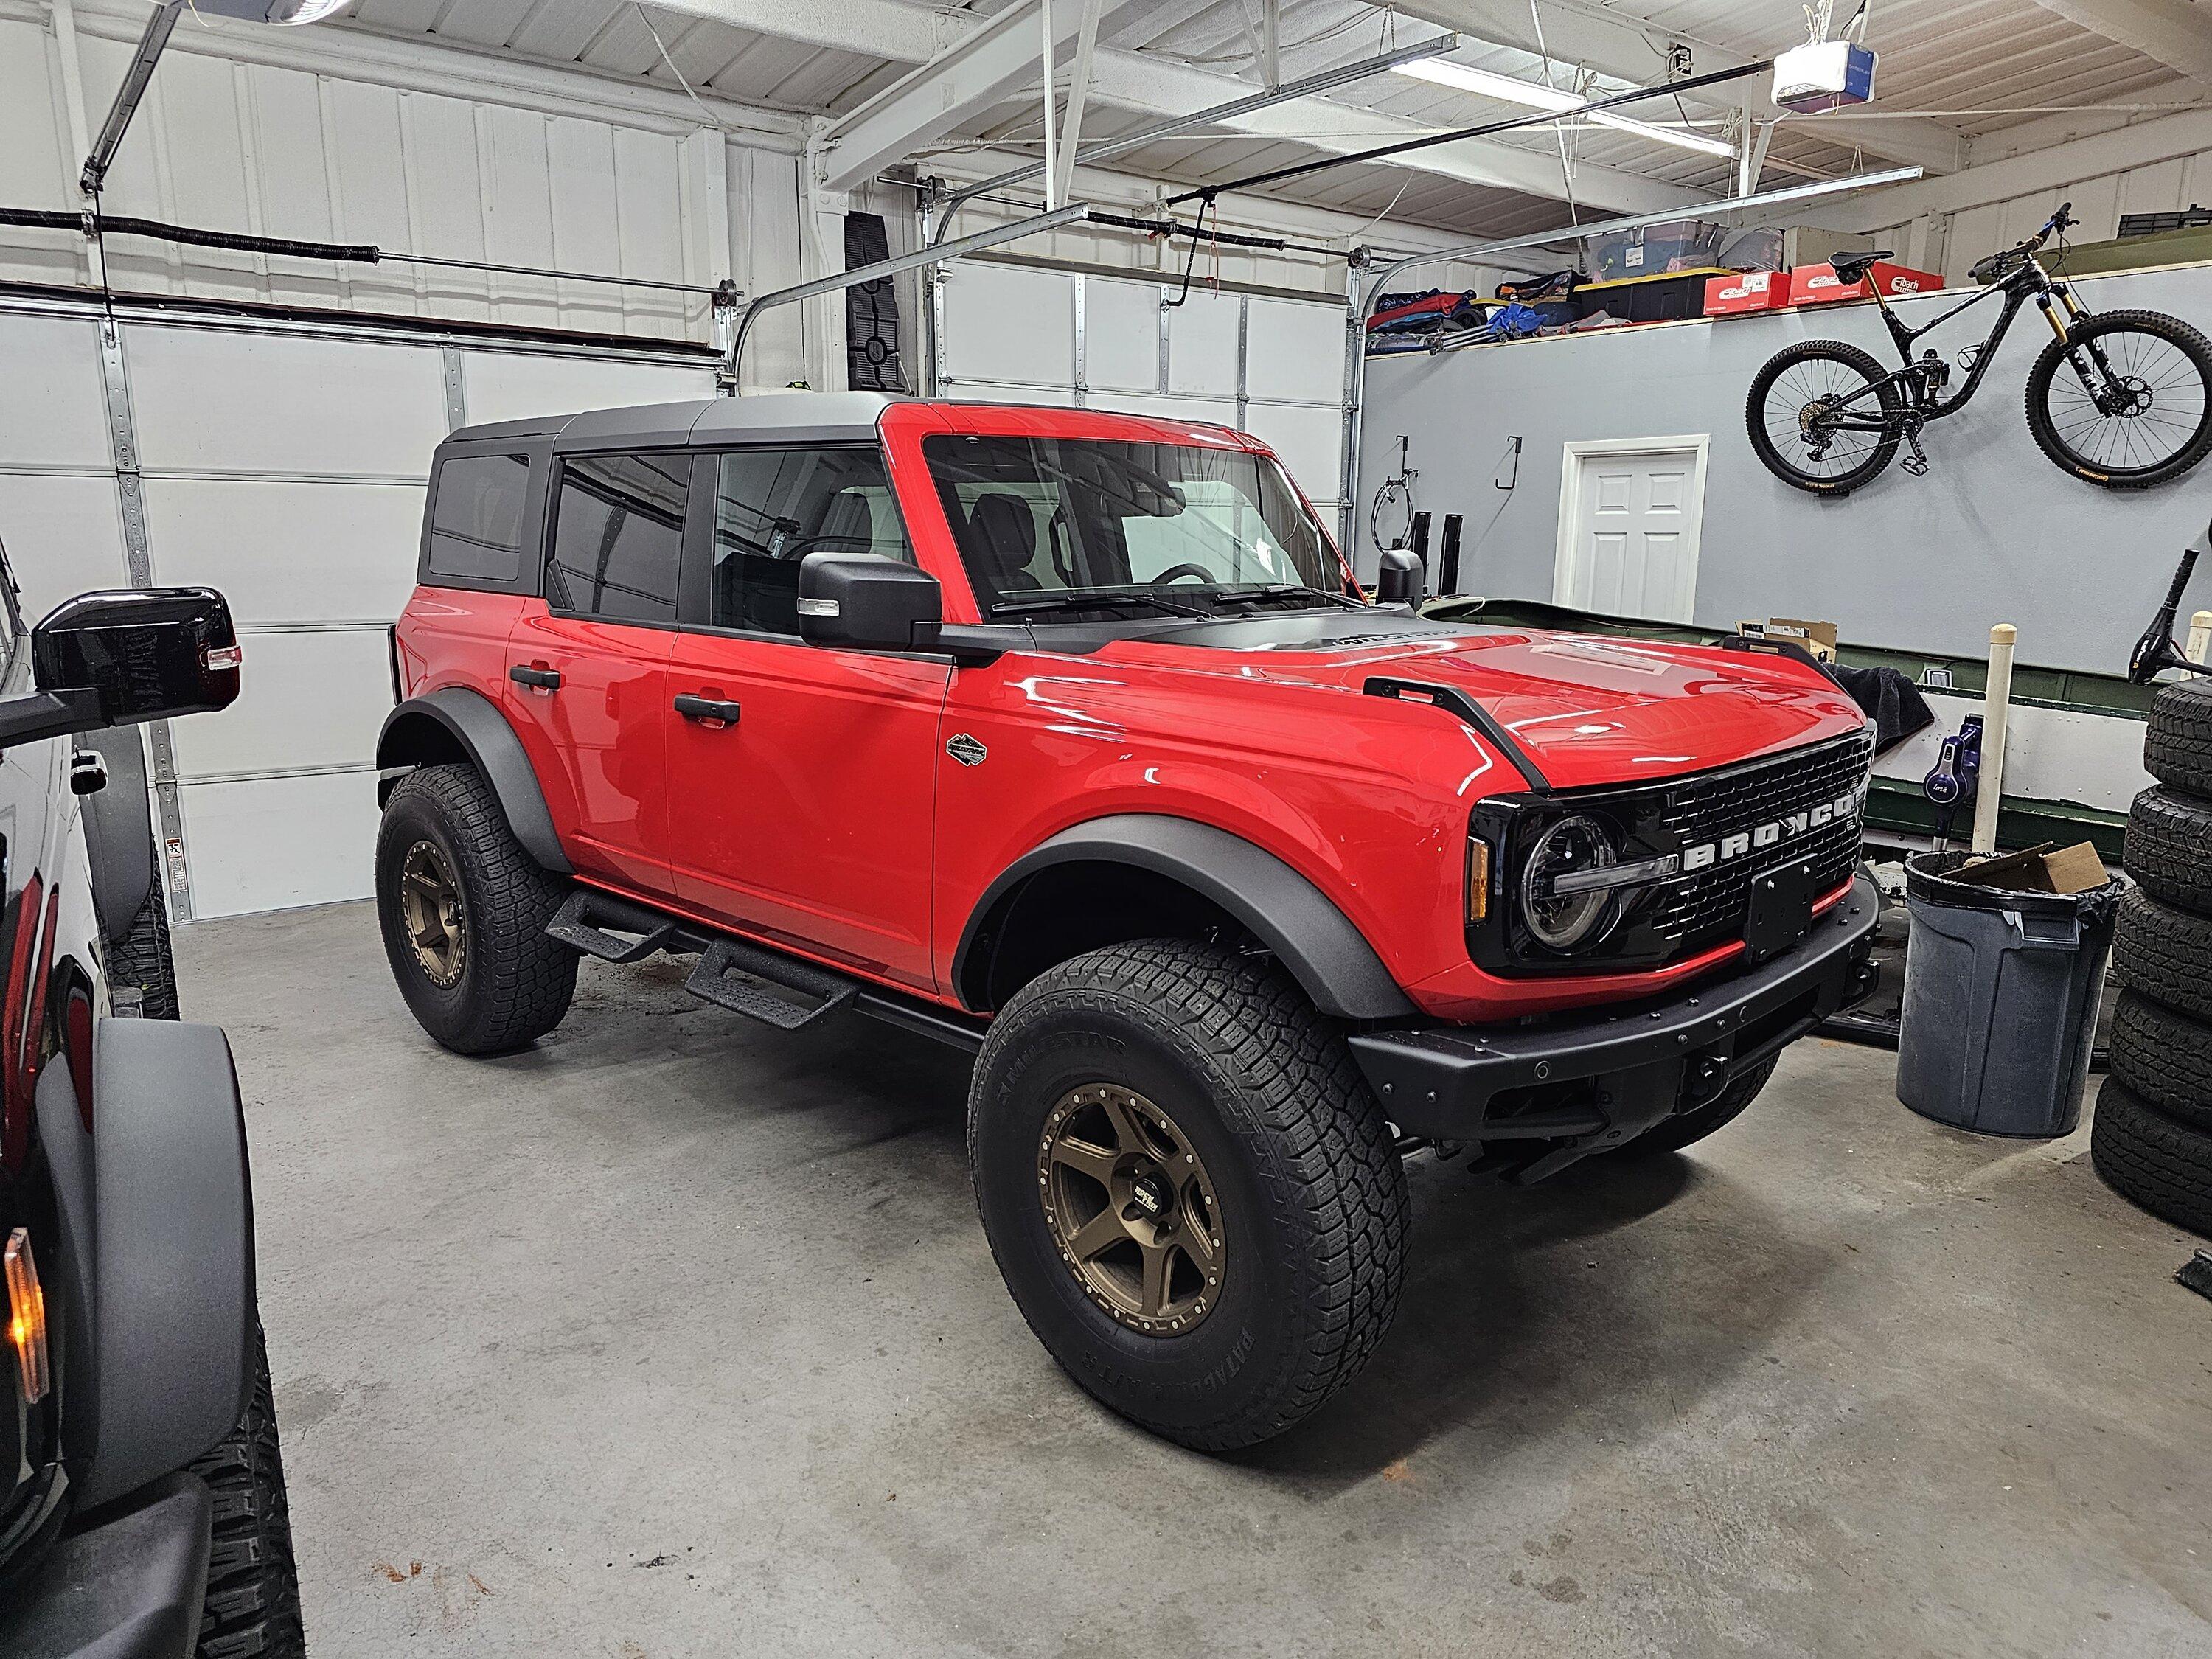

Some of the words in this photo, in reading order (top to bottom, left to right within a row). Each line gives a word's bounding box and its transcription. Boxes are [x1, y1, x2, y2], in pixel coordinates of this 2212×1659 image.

[1808, 275, 1840, 288] Eibac
[1891, 276, 1919, 293] Eibach
[948, 743, 985, 757] WILDTRAK
[1683, 793, 1854, 871] BRONCO
